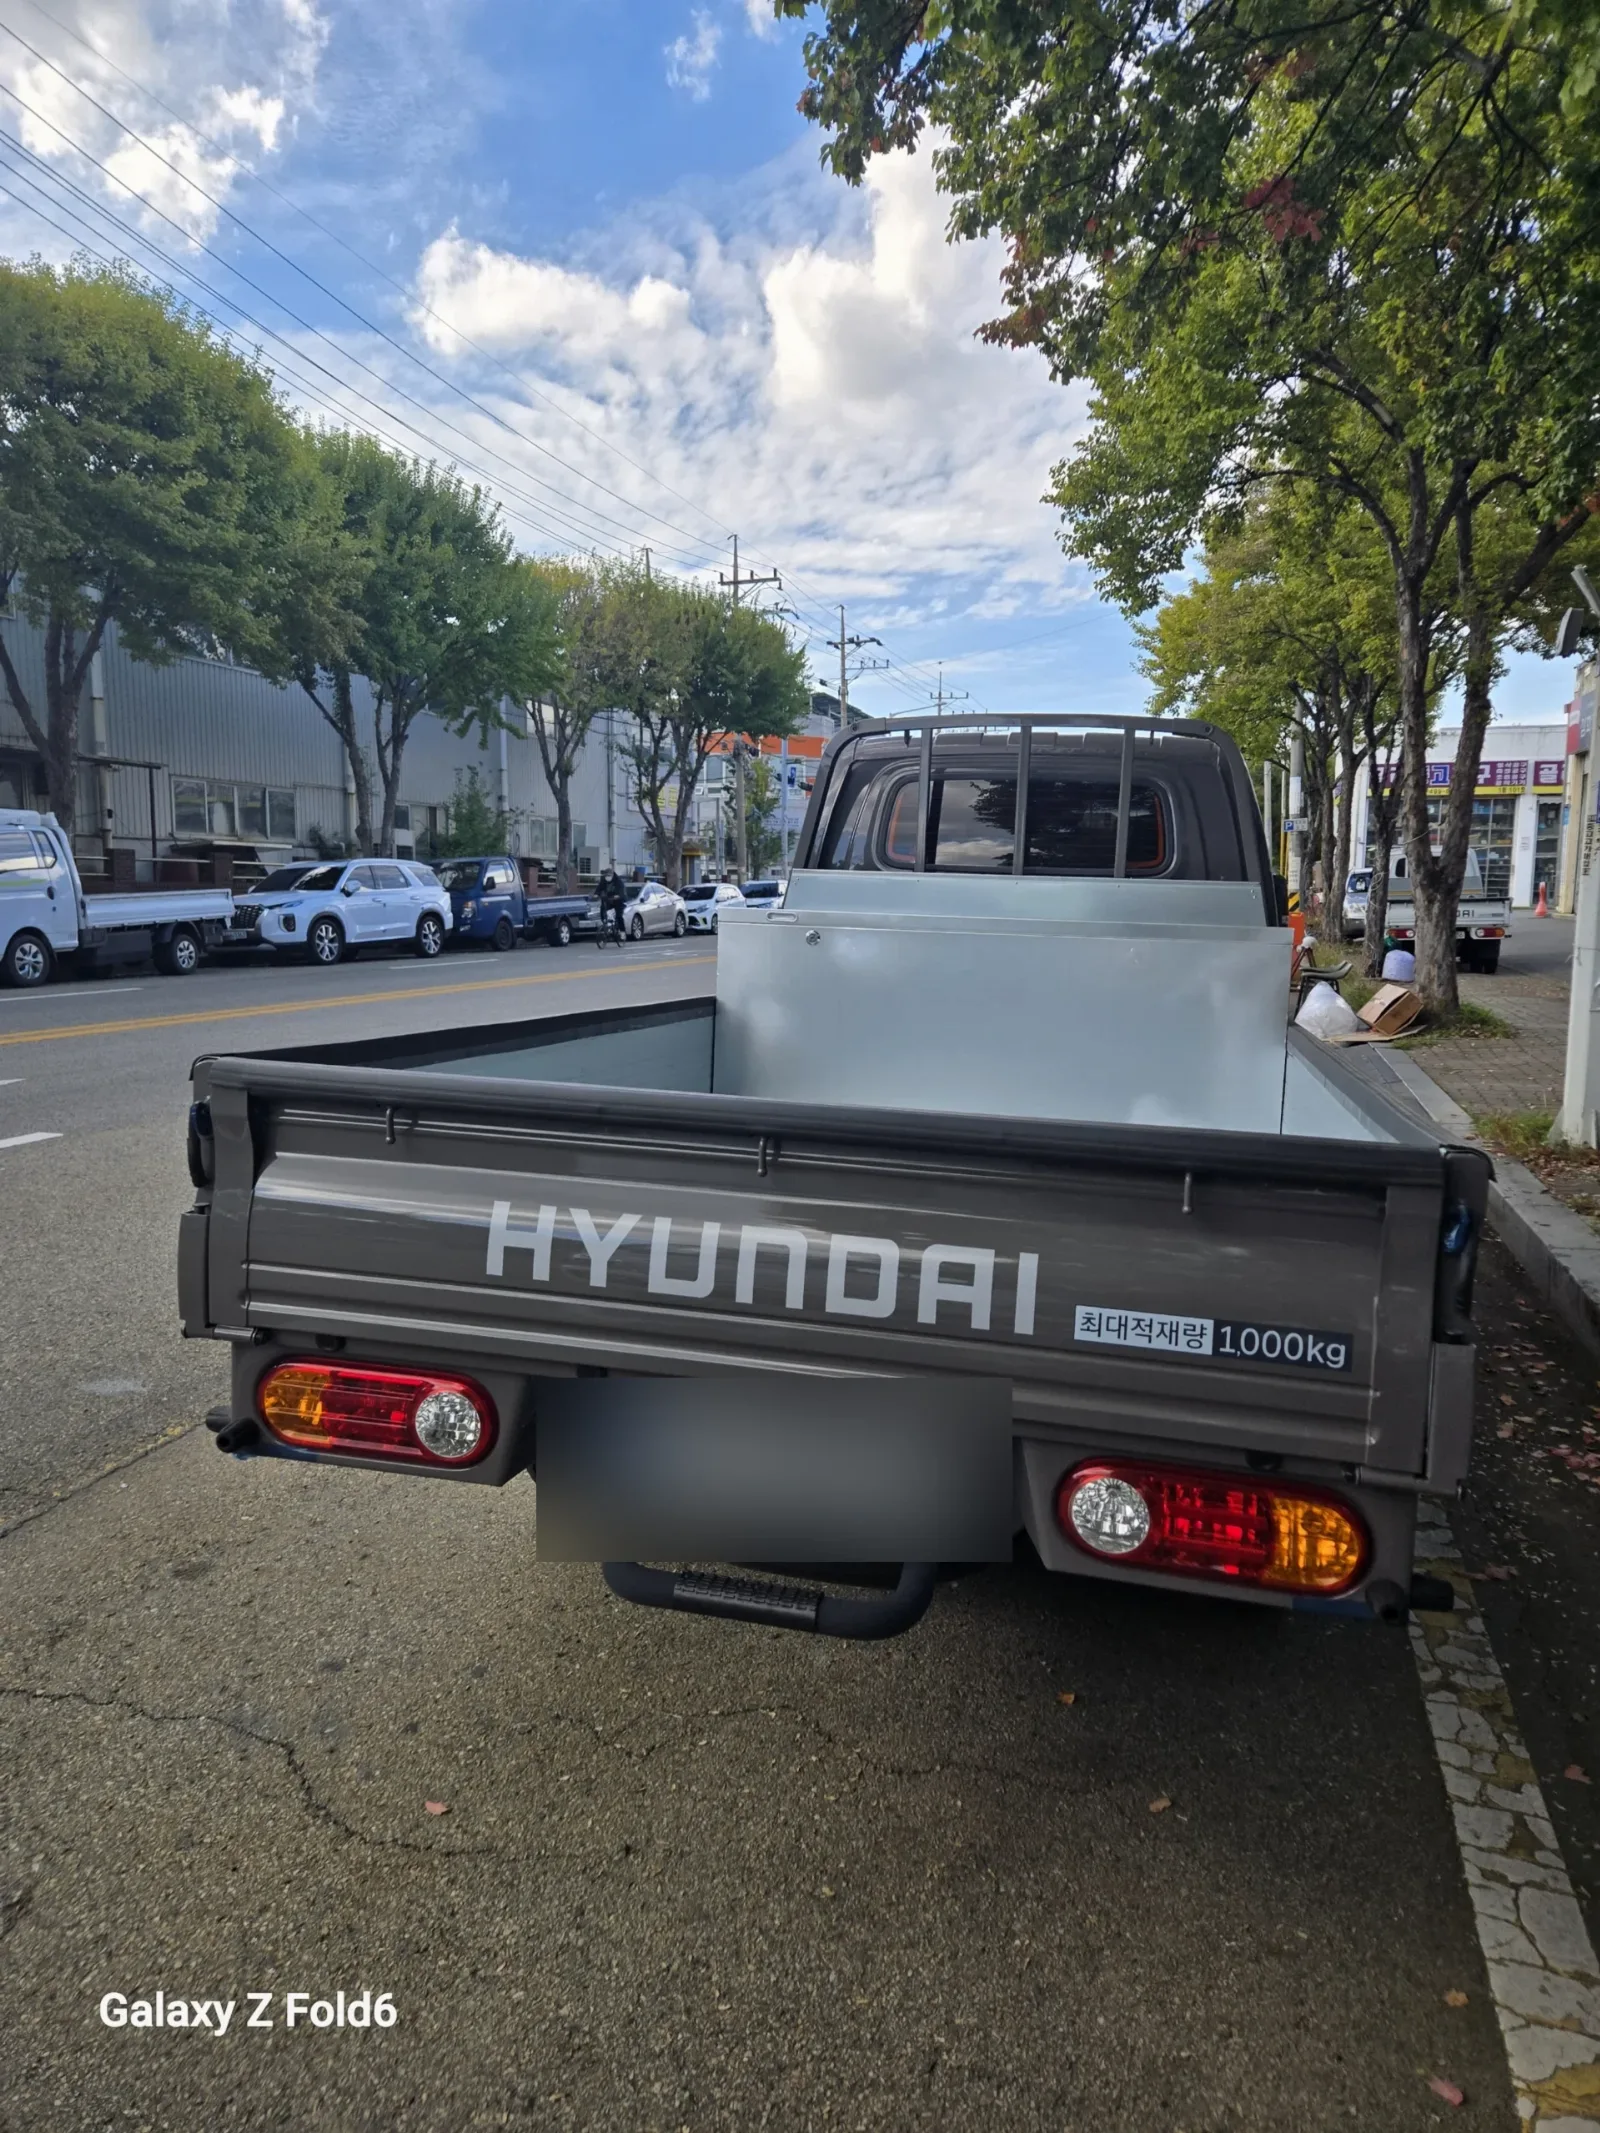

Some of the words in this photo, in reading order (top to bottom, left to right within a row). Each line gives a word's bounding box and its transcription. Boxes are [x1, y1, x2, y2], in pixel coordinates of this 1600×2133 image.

[486, 1200, 1039, 1335] HYUNDAI
[1079, 1311, 1208, 1349] 최대적재량
[1218, 1325, 1347, 1369] 1,000kg
